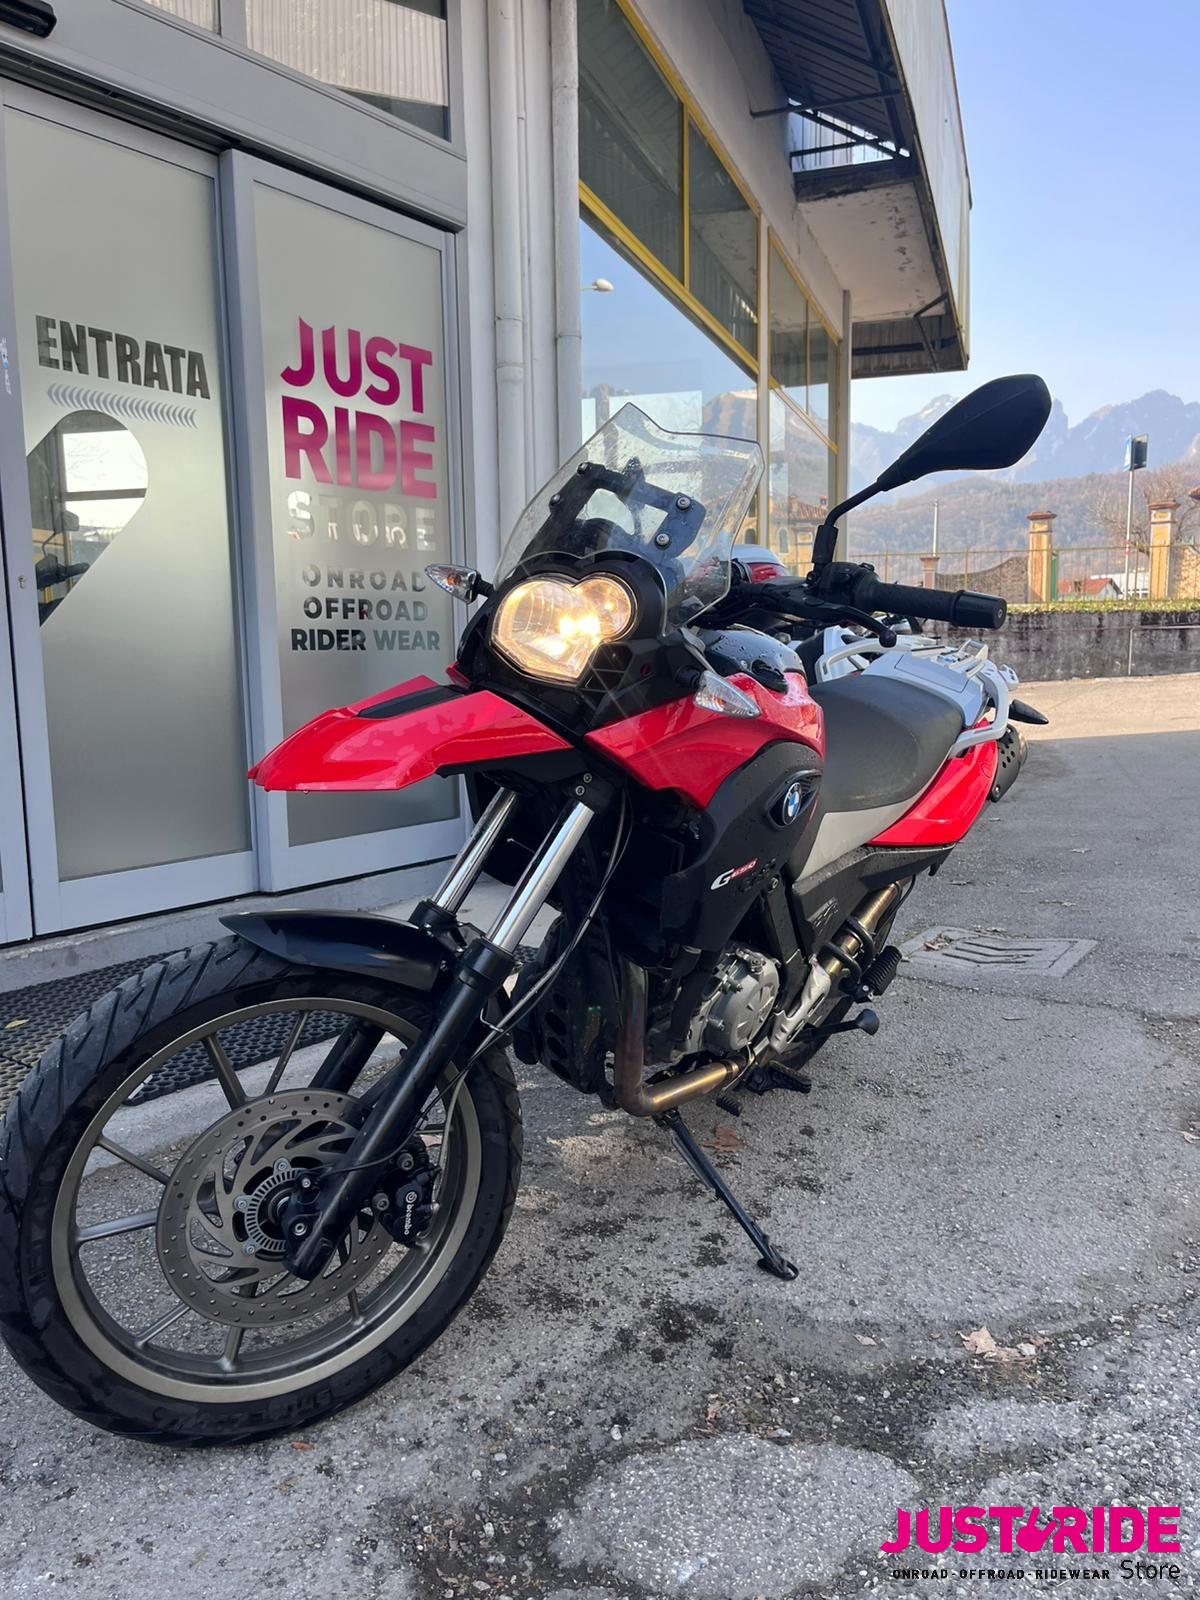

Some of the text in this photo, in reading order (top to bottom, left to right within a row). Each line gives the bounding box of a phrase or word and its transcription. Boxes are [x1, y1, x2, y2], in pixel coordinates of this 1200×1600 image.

[36, 315, 211, 400] ENTRATA
[281, 316, 433, 413] JUST
[281, 395, 437, 498] RIDE
[287, 490, 437, 551] STORE
[302, 565, 426, 592] ONROAD
[303, 597, 428, 621] OFFROAD
[291, 628, 441, 651] RIDER WEAR
[404, 1203, 415, 1236] brembo
